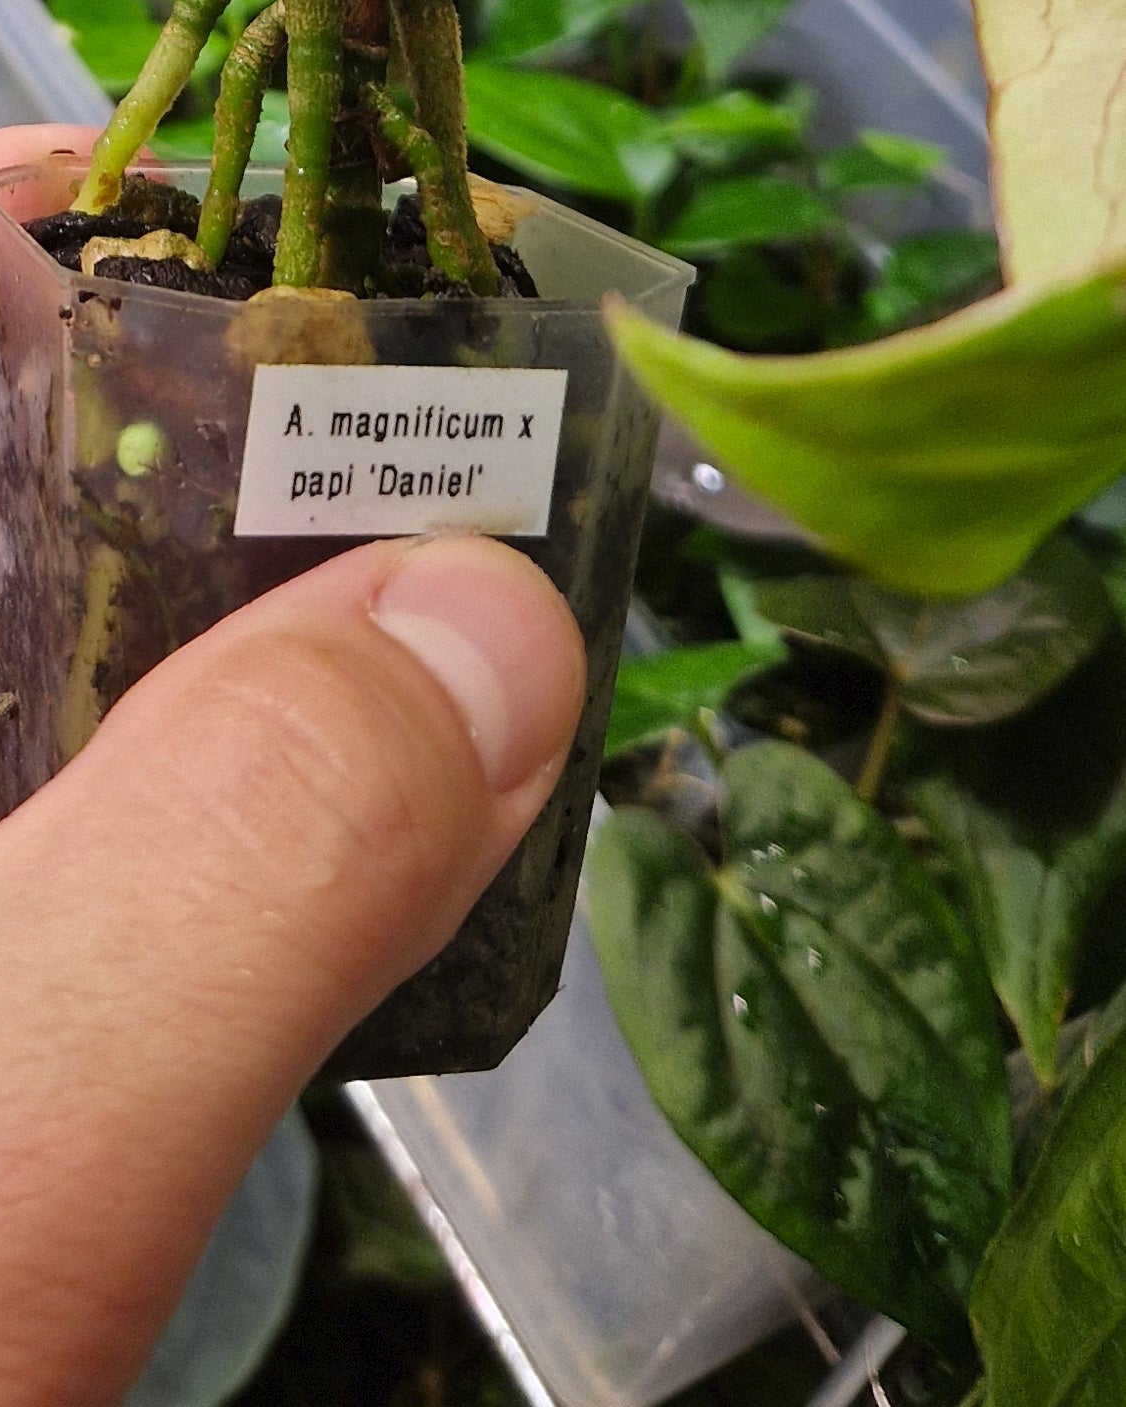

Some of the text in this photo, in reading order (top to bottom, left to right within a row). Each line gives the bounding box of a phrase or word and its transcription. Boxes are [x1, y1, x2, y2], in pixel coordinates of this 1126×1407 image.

[284, 403, 535, 442] A. magnificum x
[291, 463, 484, 501] papi 'Daniel'
